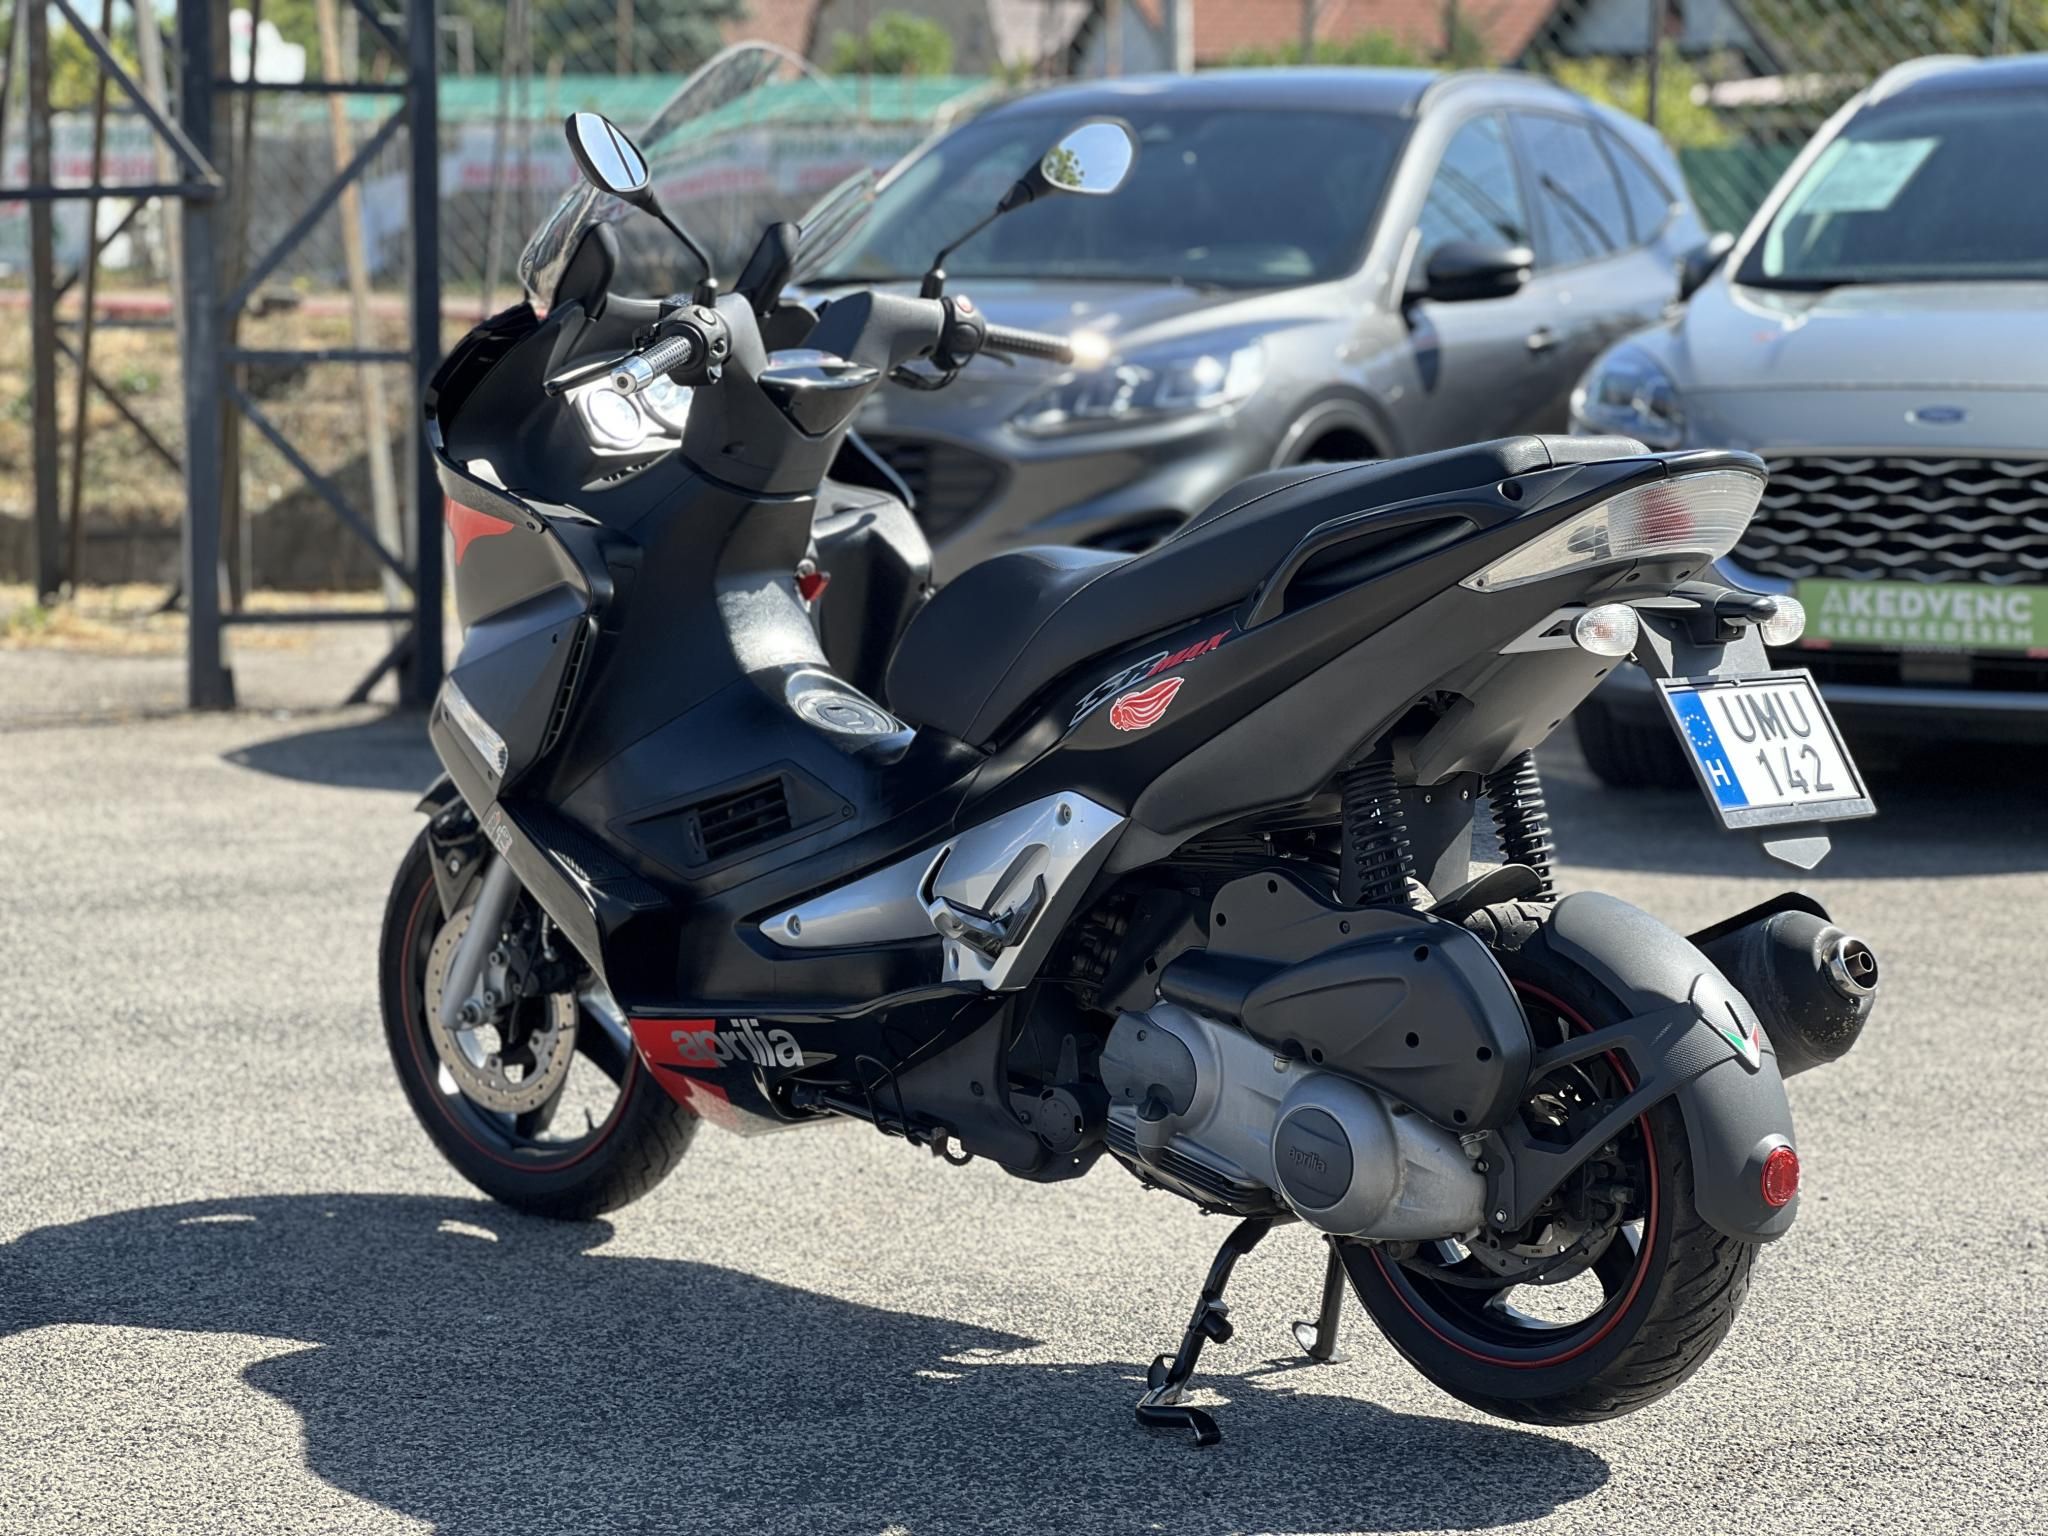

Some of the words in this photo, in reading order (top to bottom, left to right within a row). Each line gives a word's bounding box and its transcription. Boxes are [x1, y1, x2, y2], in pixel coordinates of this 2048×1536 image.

[1717, 690, 1812, 743] UMU
[1705, 758, 1732, 787] H
[1756, 743, 1835, 796] 142
[670, 1018, 805, 1068] aprilia
[1288, 1146, 1327, 1175] aprilia
